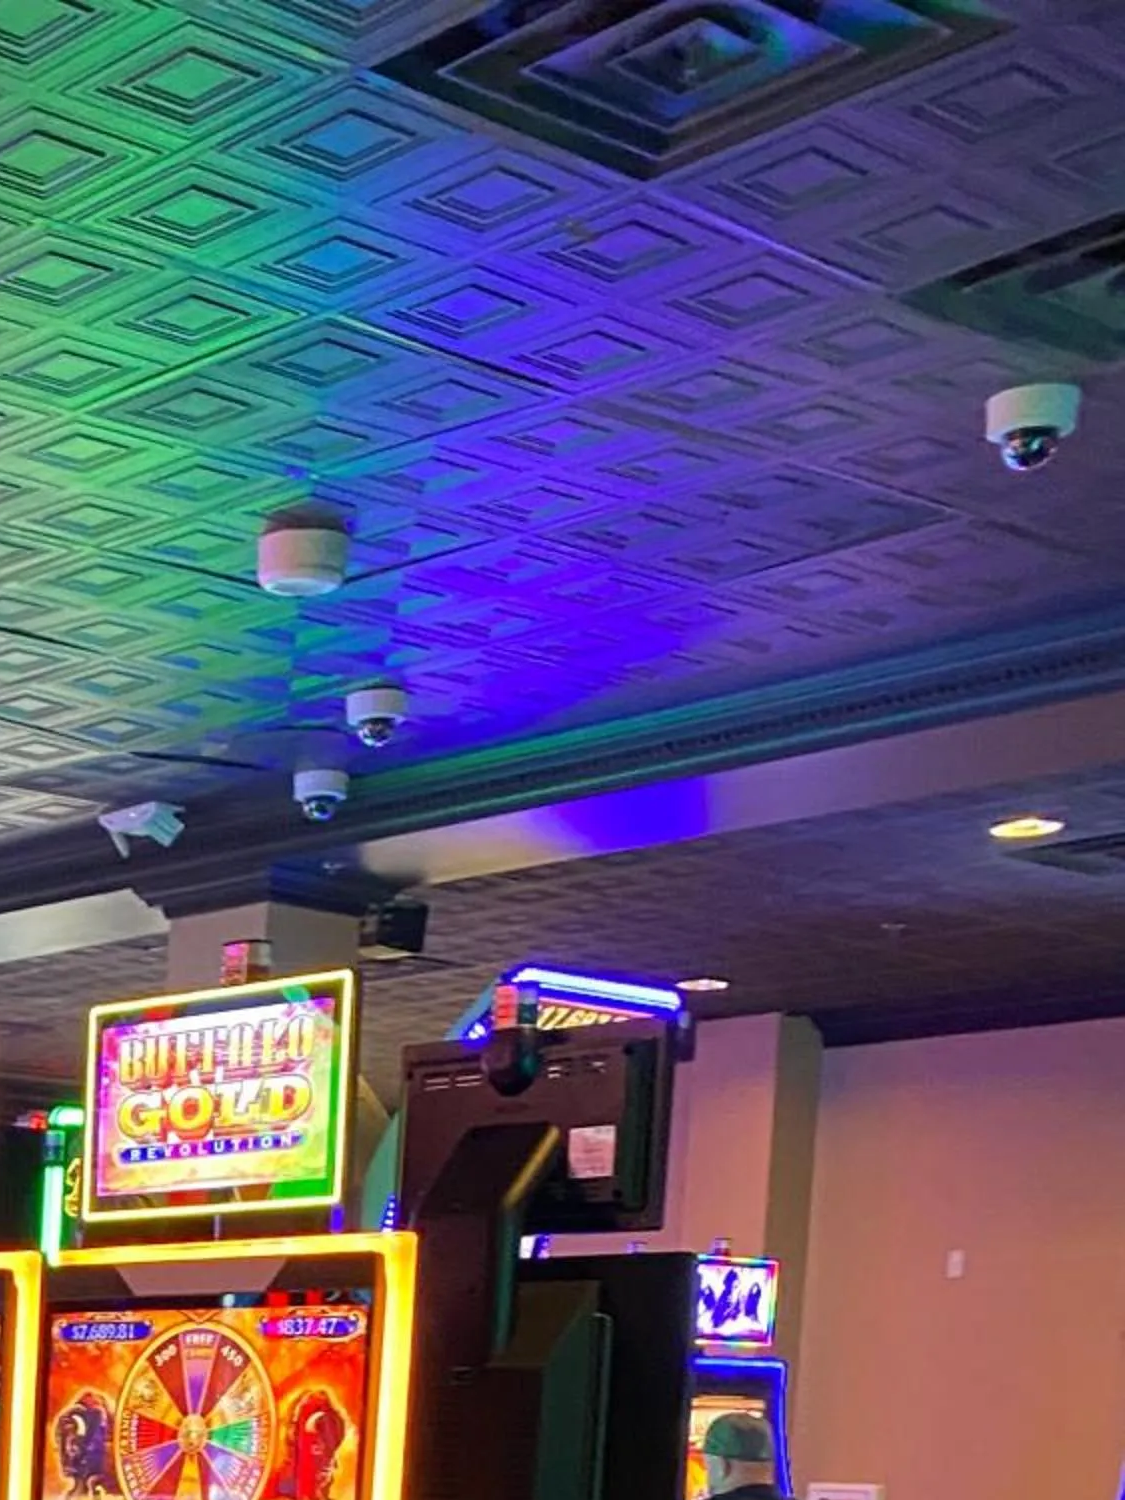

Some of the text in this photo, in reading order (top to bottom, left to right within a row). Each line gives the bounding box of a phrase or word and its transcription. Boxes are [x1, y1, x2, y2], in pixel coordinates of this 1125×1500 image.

[119, 1014, 314, 1087] BUFFALO
[118, 1074, 313, 1140] GOLD
[129, 1134, 295, 1161] REVOLUTION
